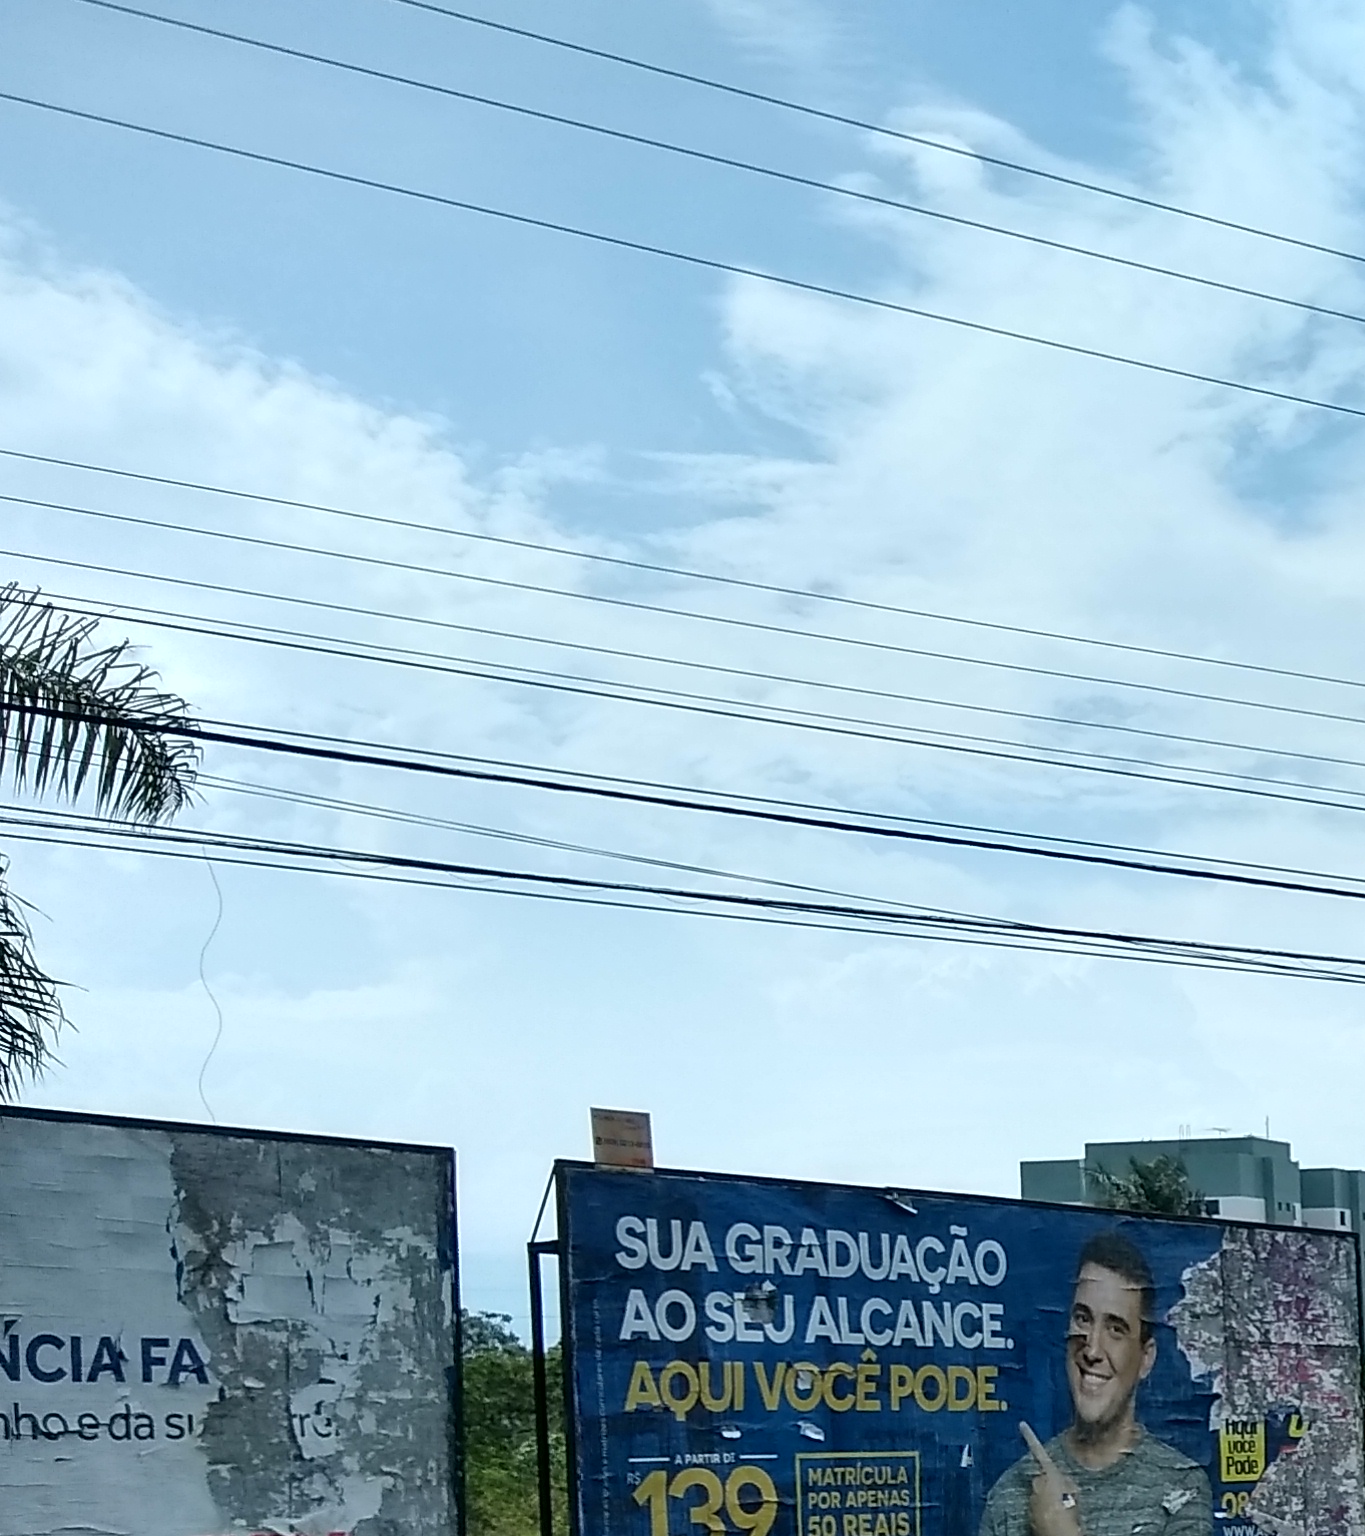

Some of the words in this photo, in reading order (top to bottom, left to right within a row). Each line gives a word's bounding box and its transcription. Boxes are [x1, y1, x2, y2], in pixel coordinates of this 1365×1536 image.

[615, 1216, 719, 1272] SUA
[725, 1222, 1007, 1294] GRADUAÇÃO
[619, 1289, 696, 1342] AO
[704, 1290, 796, 1344] SEU
[804, 1295, 1015, 1350] ALCANCE.
[624, 1360, 745, 1421] AQUI
[753, 1347, 881, 1412] VOCÊ
[890, 1364, 1008, 1412] PODE.
[108, 1403, 155, 1440] da
[674, 1454, 683, 1465] A
[685, 1453, 721, 1465] PARTIR
[723, 1452, 736, 1463] DE
[1226, 1456, 1259, 1476] Pode
[807, 1462, 908, 1487] MATRÍCULA
[807, 1491, 841, 1509] POR
[845, 1489, 910, 1508] APENAS
